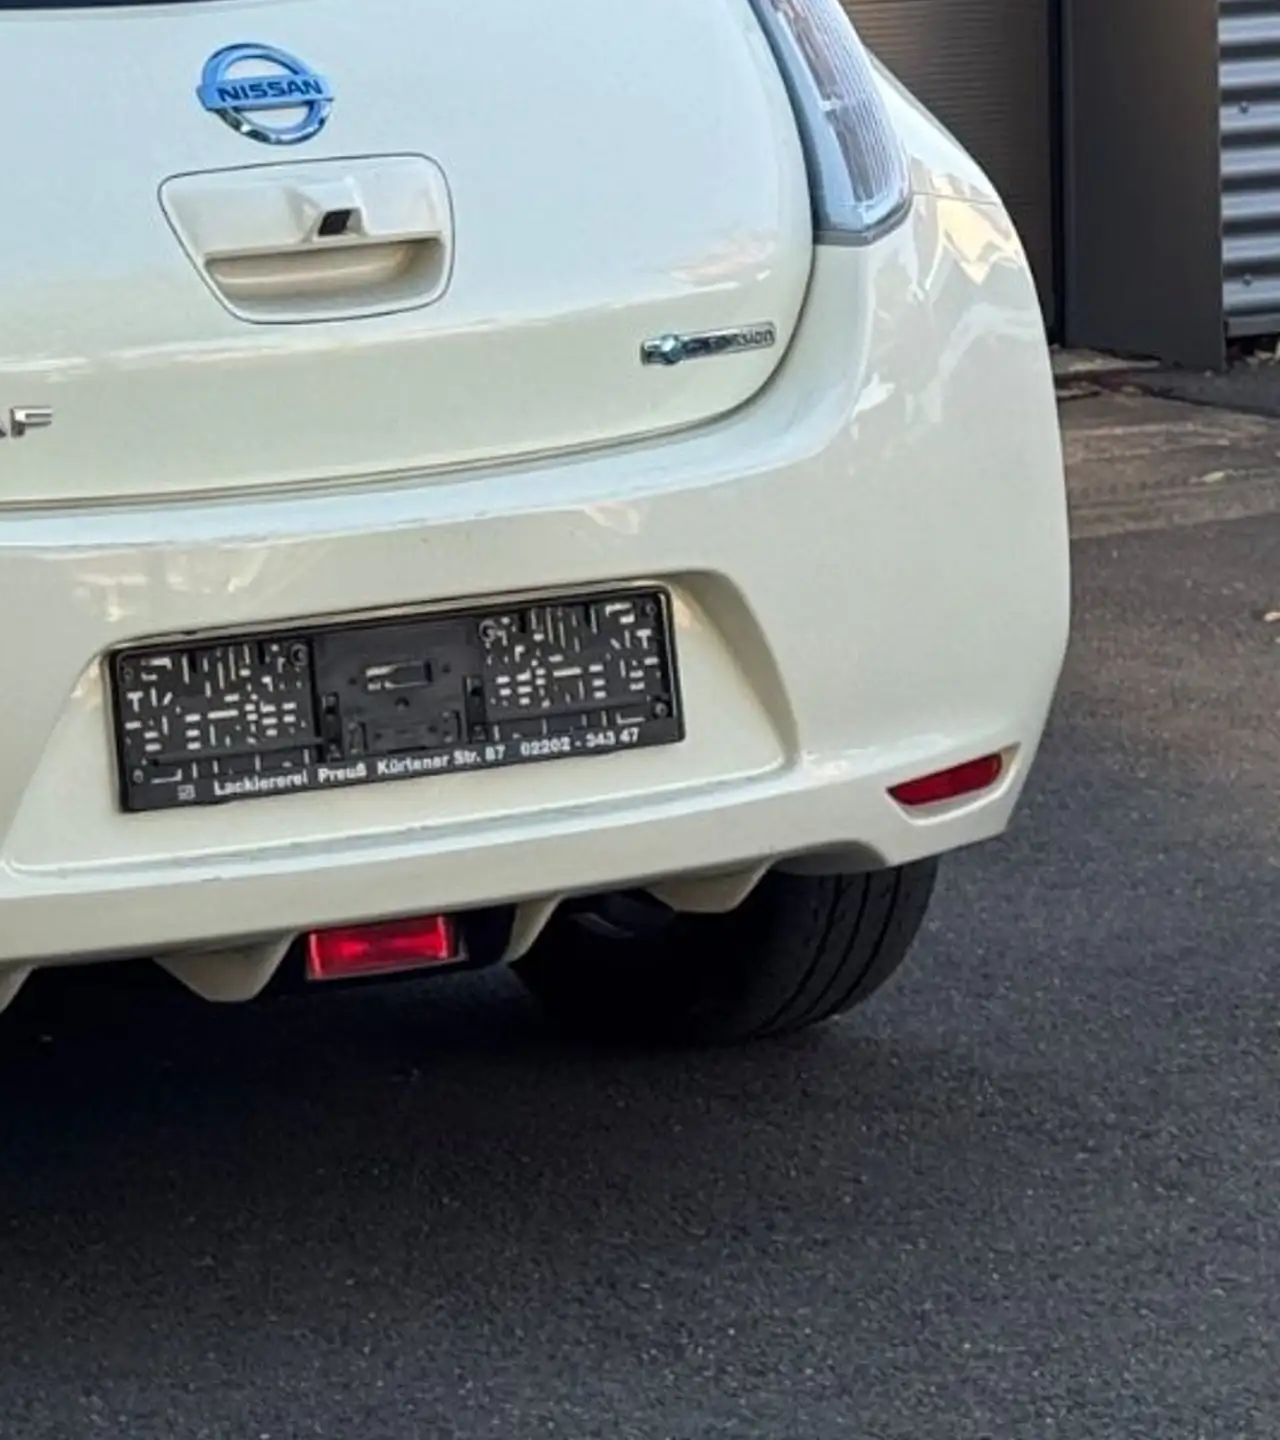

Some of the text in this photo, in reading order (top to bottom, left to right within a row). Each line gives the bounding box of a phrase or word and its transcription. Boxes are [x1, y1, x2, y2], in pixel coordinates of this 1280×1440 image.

[218, 79, 323, 102] NISSAN
[214, 770, 309, 796] Lackiererei
[318, 763, 367, 782] Preuß
[454, 749, 481, 765] Str.
